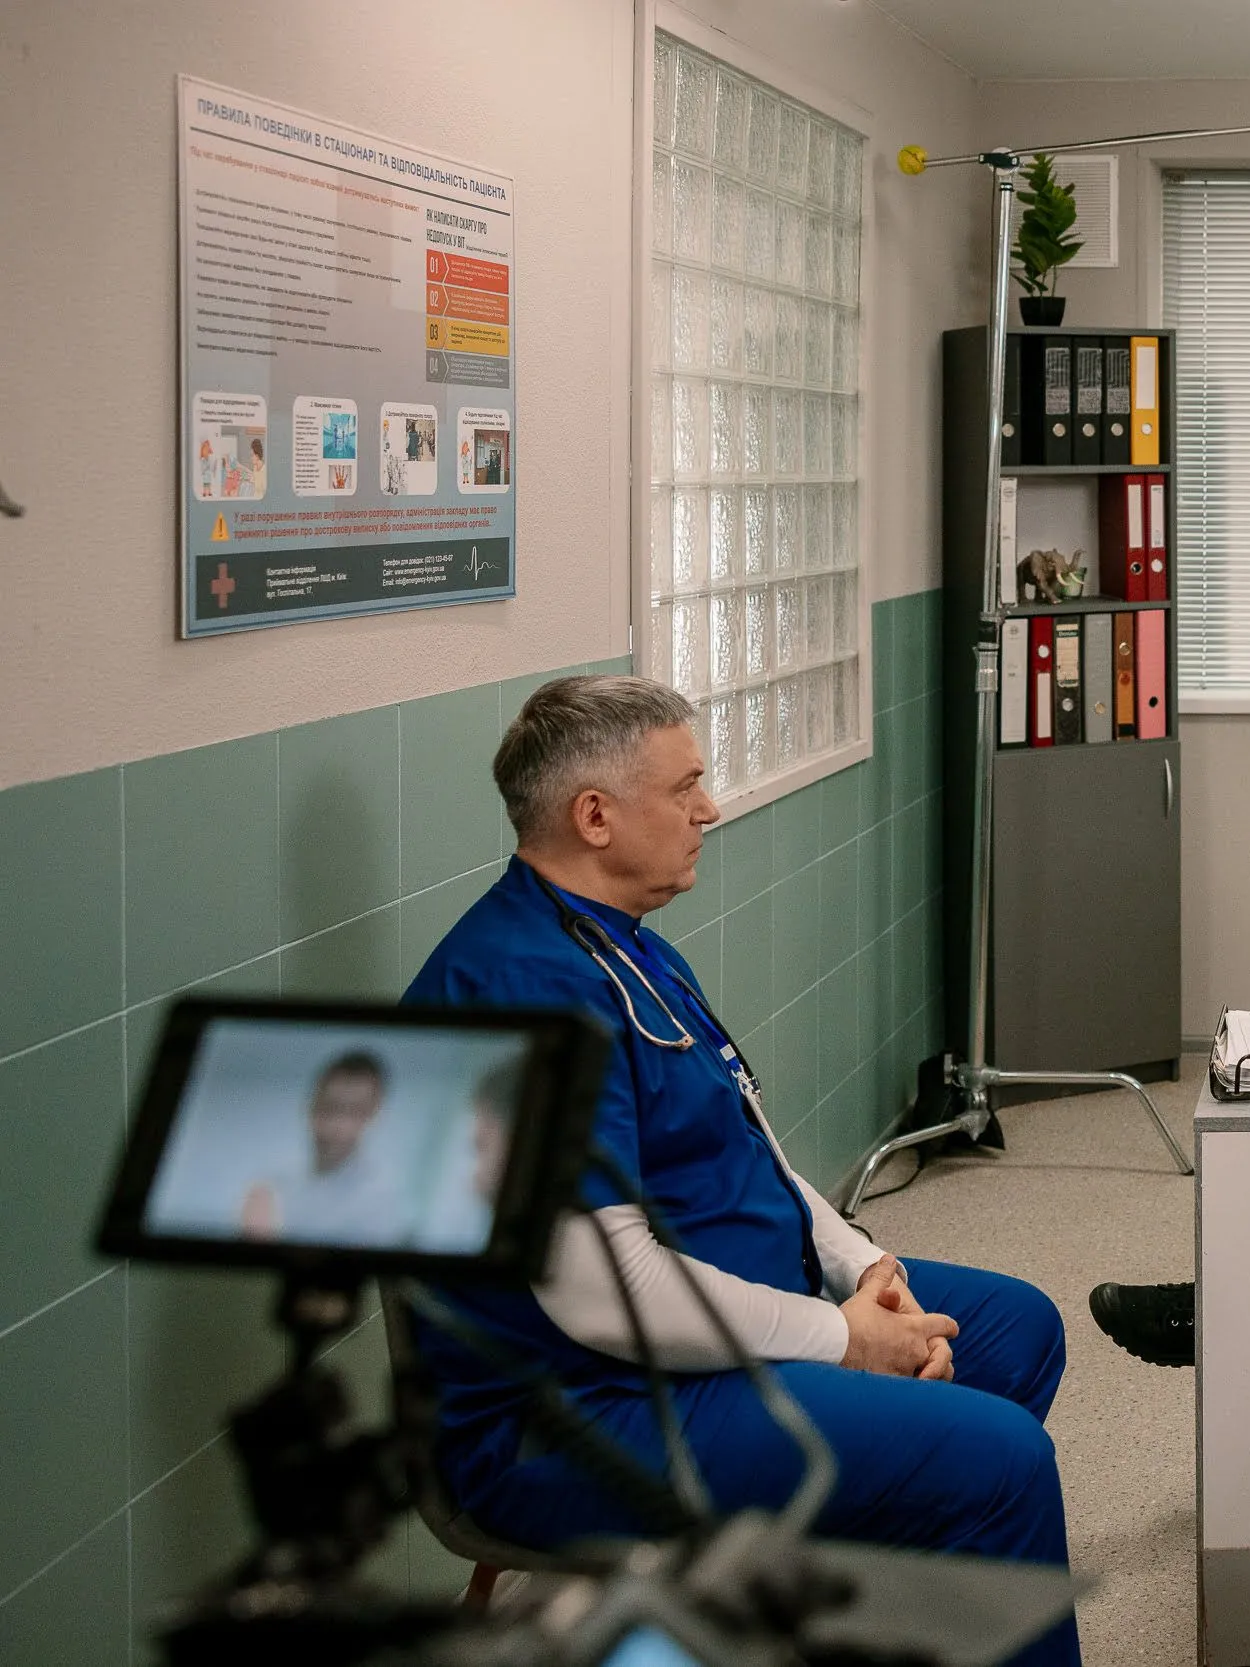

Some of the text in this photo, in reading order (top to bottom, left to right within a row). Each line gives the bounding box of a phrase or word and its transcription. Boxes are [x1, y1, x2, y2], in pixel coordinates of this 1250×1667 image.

[197, 99, 506, 200] ПРАВИЛА ПОВЕДІНКИ В СТАЦІОНАРІ ТА ВІДПОВІДАЛЬНІСТЬ ПАЦІЄНТА
[434, 210, 458, 228] НАПИСАТИ
[460, 217, 477, 232] СКАРГУ
[478, 221, 487, 234] ПРО
[426, 229, 453, 244] НЕДОПУСК
[430, 257, 438, 273] 01
[430, 290, 438, 307] 02
[430, 324, 438, 340] 03
[429, 357, 438, 374] 04
